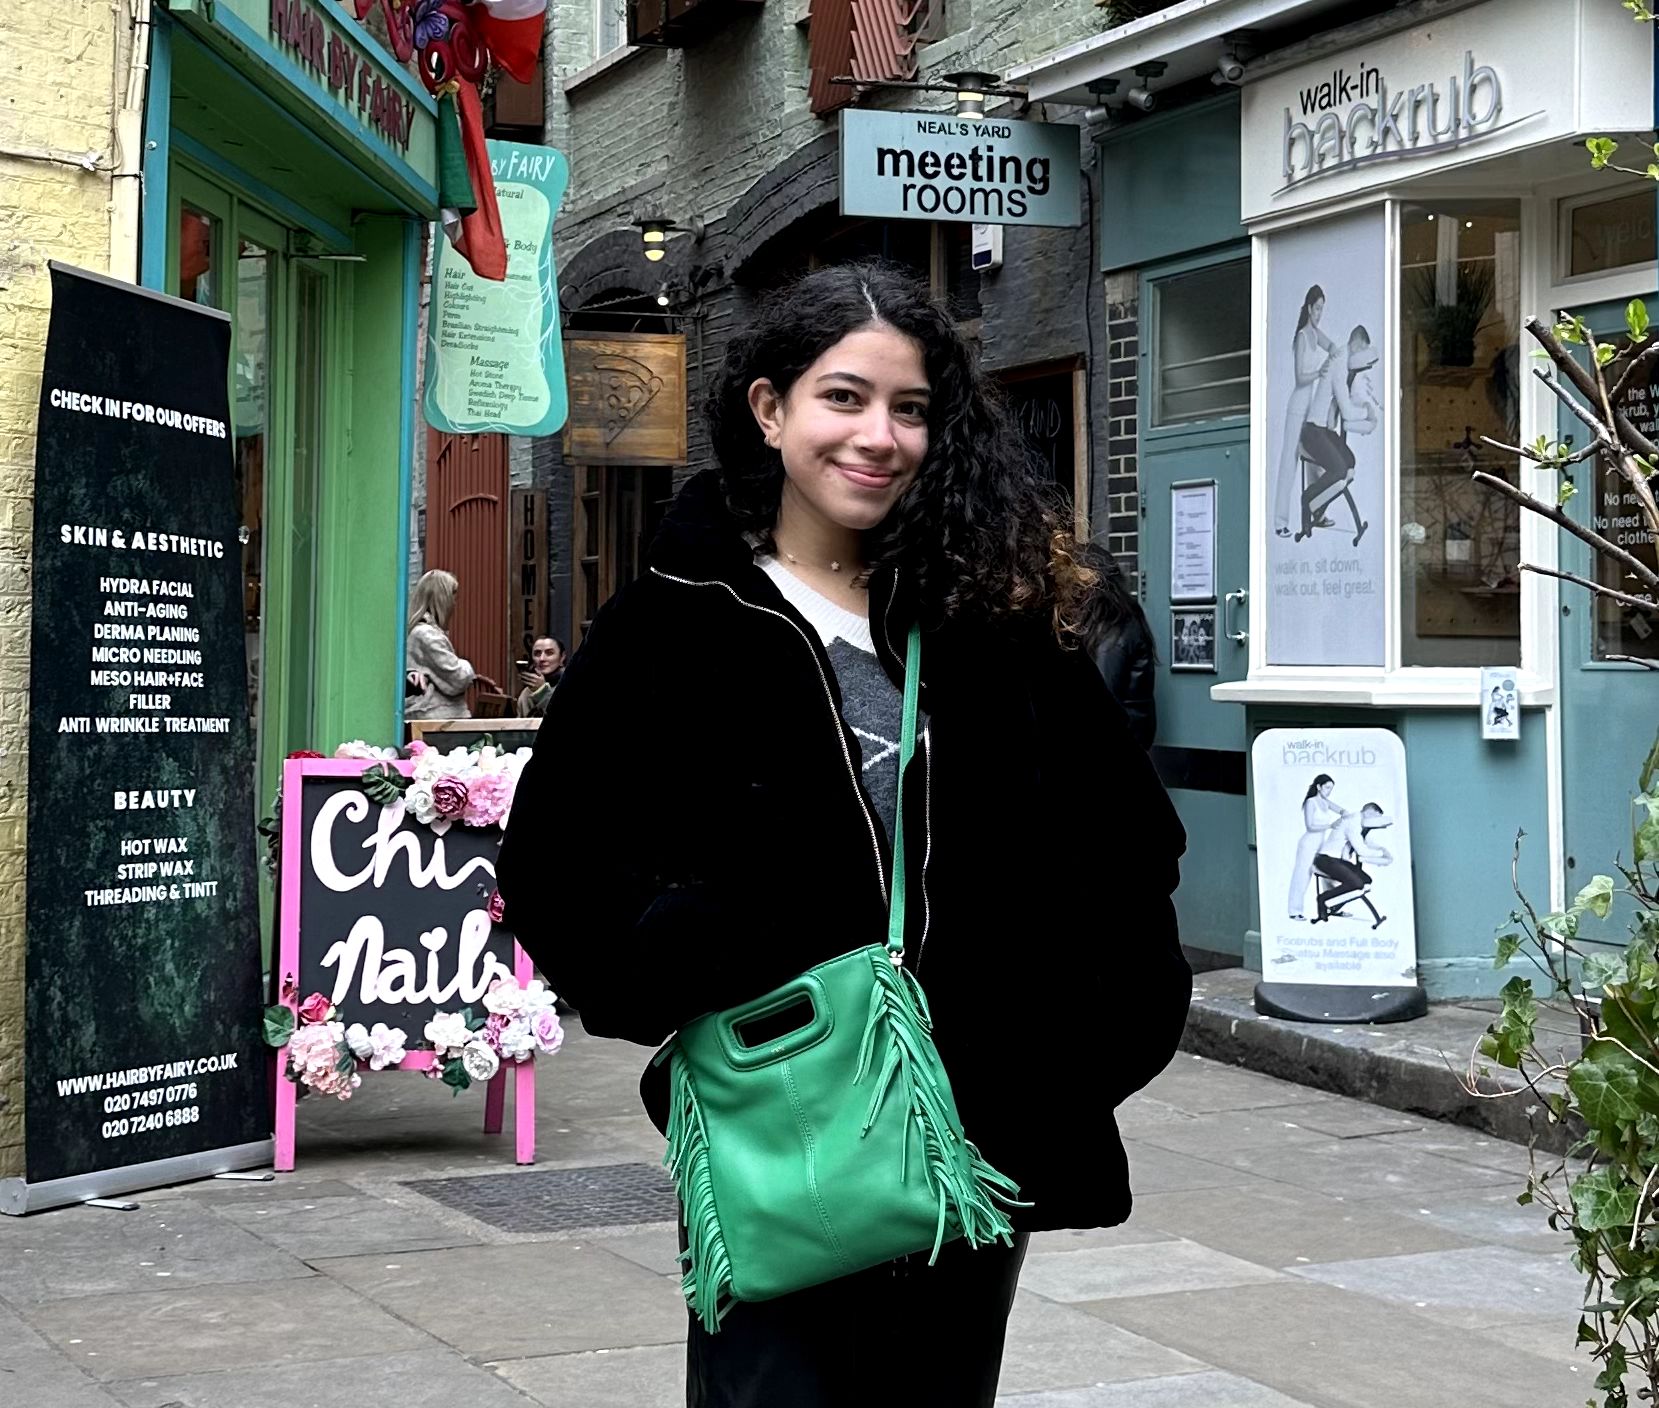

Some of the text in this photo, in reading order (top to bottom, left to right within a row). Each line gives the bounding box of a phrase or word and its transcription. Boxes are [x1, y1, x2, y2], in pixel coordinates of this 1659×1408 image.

[272, 0, 415, 152] HAIR BY FAIRY
[1300, 62, 1380, 115] walk-in
[1282, 50, 1502, 181] backrub
[917, 120, 1012, 139] NEAL'S YARD
[507, 151, 556, 182] FAIRY
[877, 145, 1050, 196] meeting
[903, 183, 1027, 217] rooms
[513, 240, 538, 255] Body
[444, 268, 466, 280] Hair
[470, 356, 509, 371] Massage
[1628, 387, 1646, 402] the
[50, 388, 226, 439] CHECK IN FOR OUR OFFERS
[1604, 493, 1620, 506] No
[1594, 515, 1609, 530] No
[1611, 513, 1640, 528] need
[60, 524, 224, 559] SKIN & AESTHETIC
[1275, 558, 1298, 575] walk
[1315, 557, 1327, 574] sit
[1329, 556, 1362, 576] down,
[100, 576, 194, 598] HYDRA FACIAL
[1275, 580, 1298, 596] walk
[1322, 579, 1342, 596] feel
[1344, 580, 1375, 599] great.
[103, 600, 188, 620] ANTI-AGING
[94, 623, 200, 643] DERMA PLANING
[92, 646, 202, 667] MICRO NEEDLING
[90, 670, 204, 688] MESO HAIR+FACE
[129, 693, 171, 710] FILLER
[58, 717, 231, 734] ANTI WRINKLE TREATMENT
[1286, 740, 1324, 750] walk-in
[1282, 745, 1376, 766] backrub
[114, 789, 196, 810] BEAUTY
[120, 837, 188, 856] HOT WAX
[117, 860, 194, 880] STRIP WAX
[84, 885, 167, 907] THREADING
[169, 885, 180, 900] &
[1326, 937, 1347, 947] and
[1349, 937, 1369, 948] Full
[1371, 938, 1399, 951] Body
[57, 1053, 238, 1097] WWW.HAIRBYFAIRY.CO.UK
[104, 1082, 197, 1114] 020 7497 0776
[102, 1106, 200, 1139] 020 7240 6888
